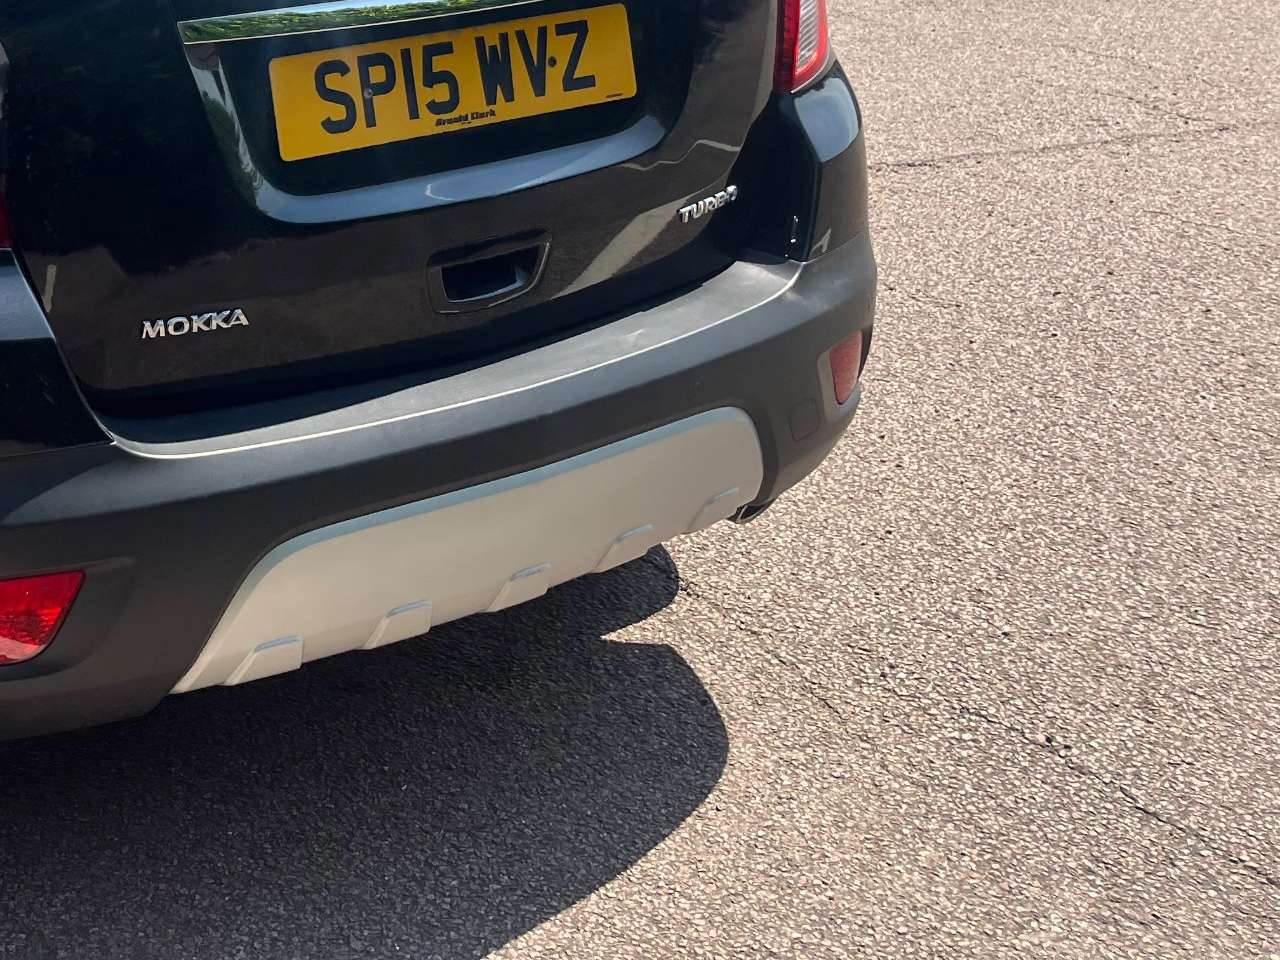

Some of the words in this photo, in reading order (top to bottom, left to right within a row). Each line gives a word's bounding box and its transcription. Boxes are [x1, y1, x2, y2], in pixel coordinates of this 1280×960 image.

[314, 40, 460, 135] SP15
[474, 19, 597, 106] WVZ
[141, 308, 249, 339] MOKKA
